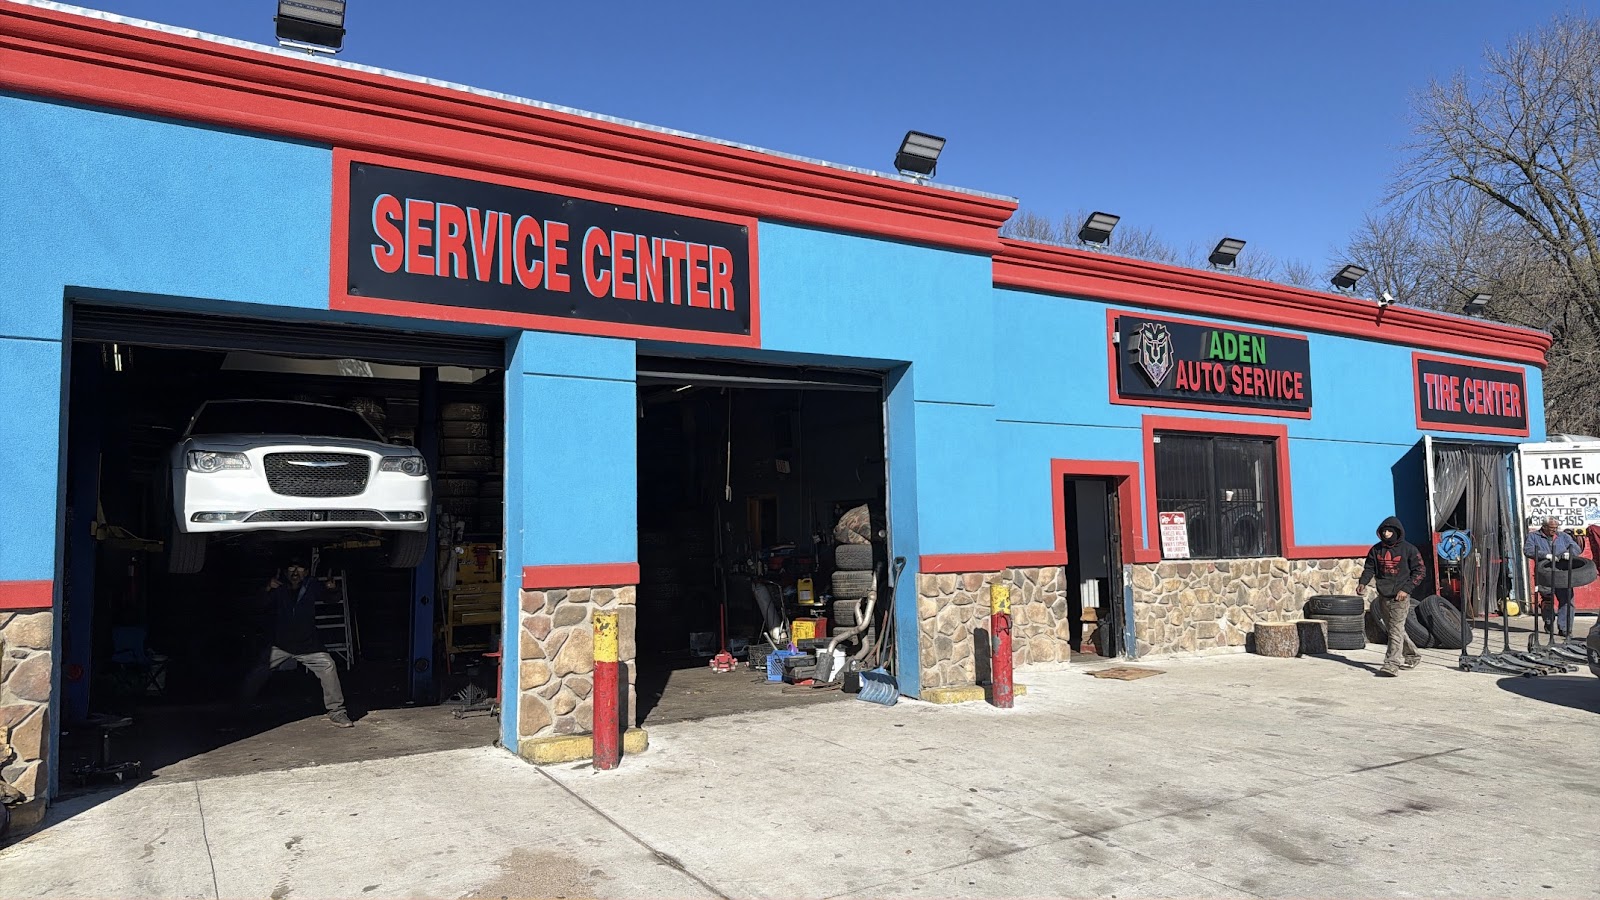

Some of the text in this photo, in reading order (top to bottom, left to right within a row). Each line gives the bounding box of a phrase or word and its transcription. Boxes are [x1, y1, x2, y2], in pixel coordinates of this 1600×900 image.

[371, 194, 735, 311] SERVICE CENTER
[1209, 331, 1266, 364] ADEN
[1175, 360, 1304, 399] AUTO SERVICE
[1424, 373, 1521, 417] TIRE CENTER
[1541, 457, 1583, 469] TIRE
[1530, 498, 1598, 507] CALL FOR
